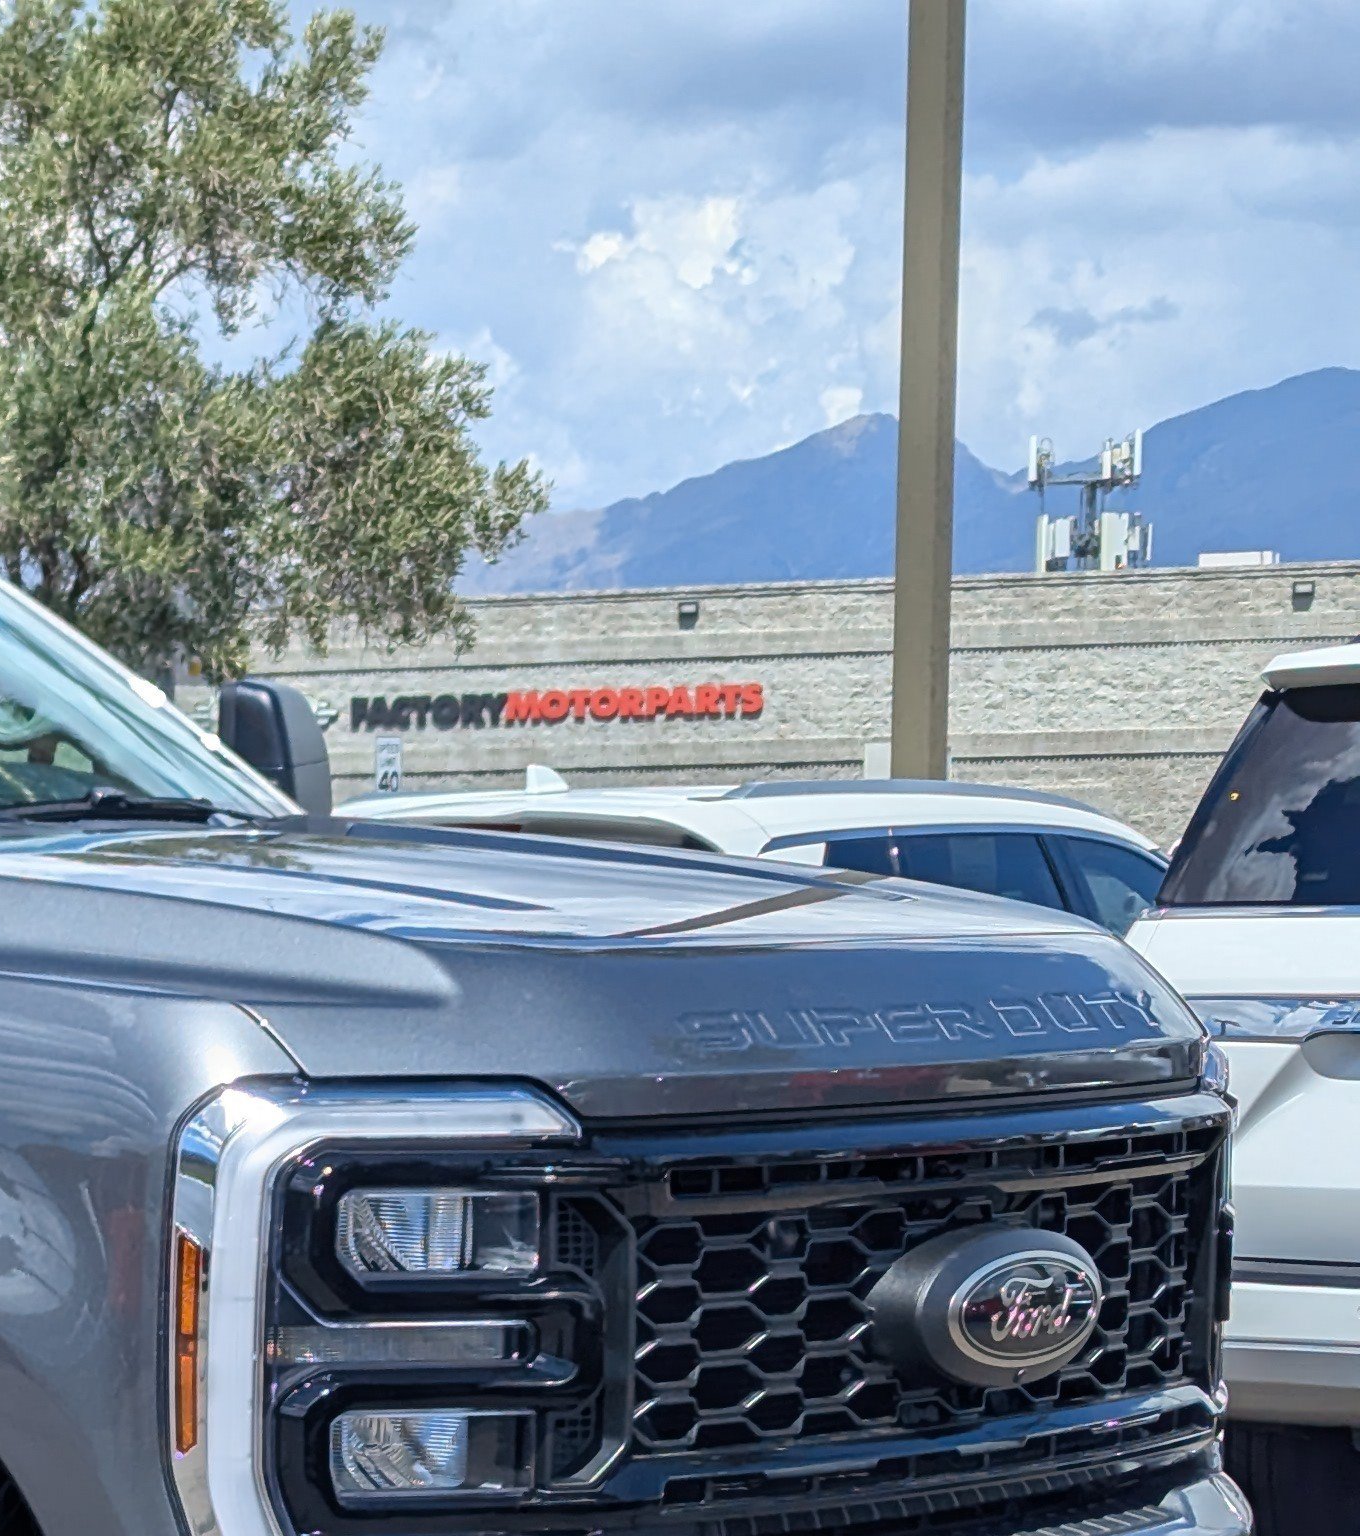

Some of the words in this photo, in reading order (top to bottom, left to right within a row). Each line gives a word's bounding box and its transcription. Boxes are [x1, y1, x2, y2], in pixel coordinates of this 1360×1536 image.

[678, 1001, 997, 1052] SUPER
[988, 988, 1160, 1038] DUTY
[990, 1276, 1072, 1342] Ford
